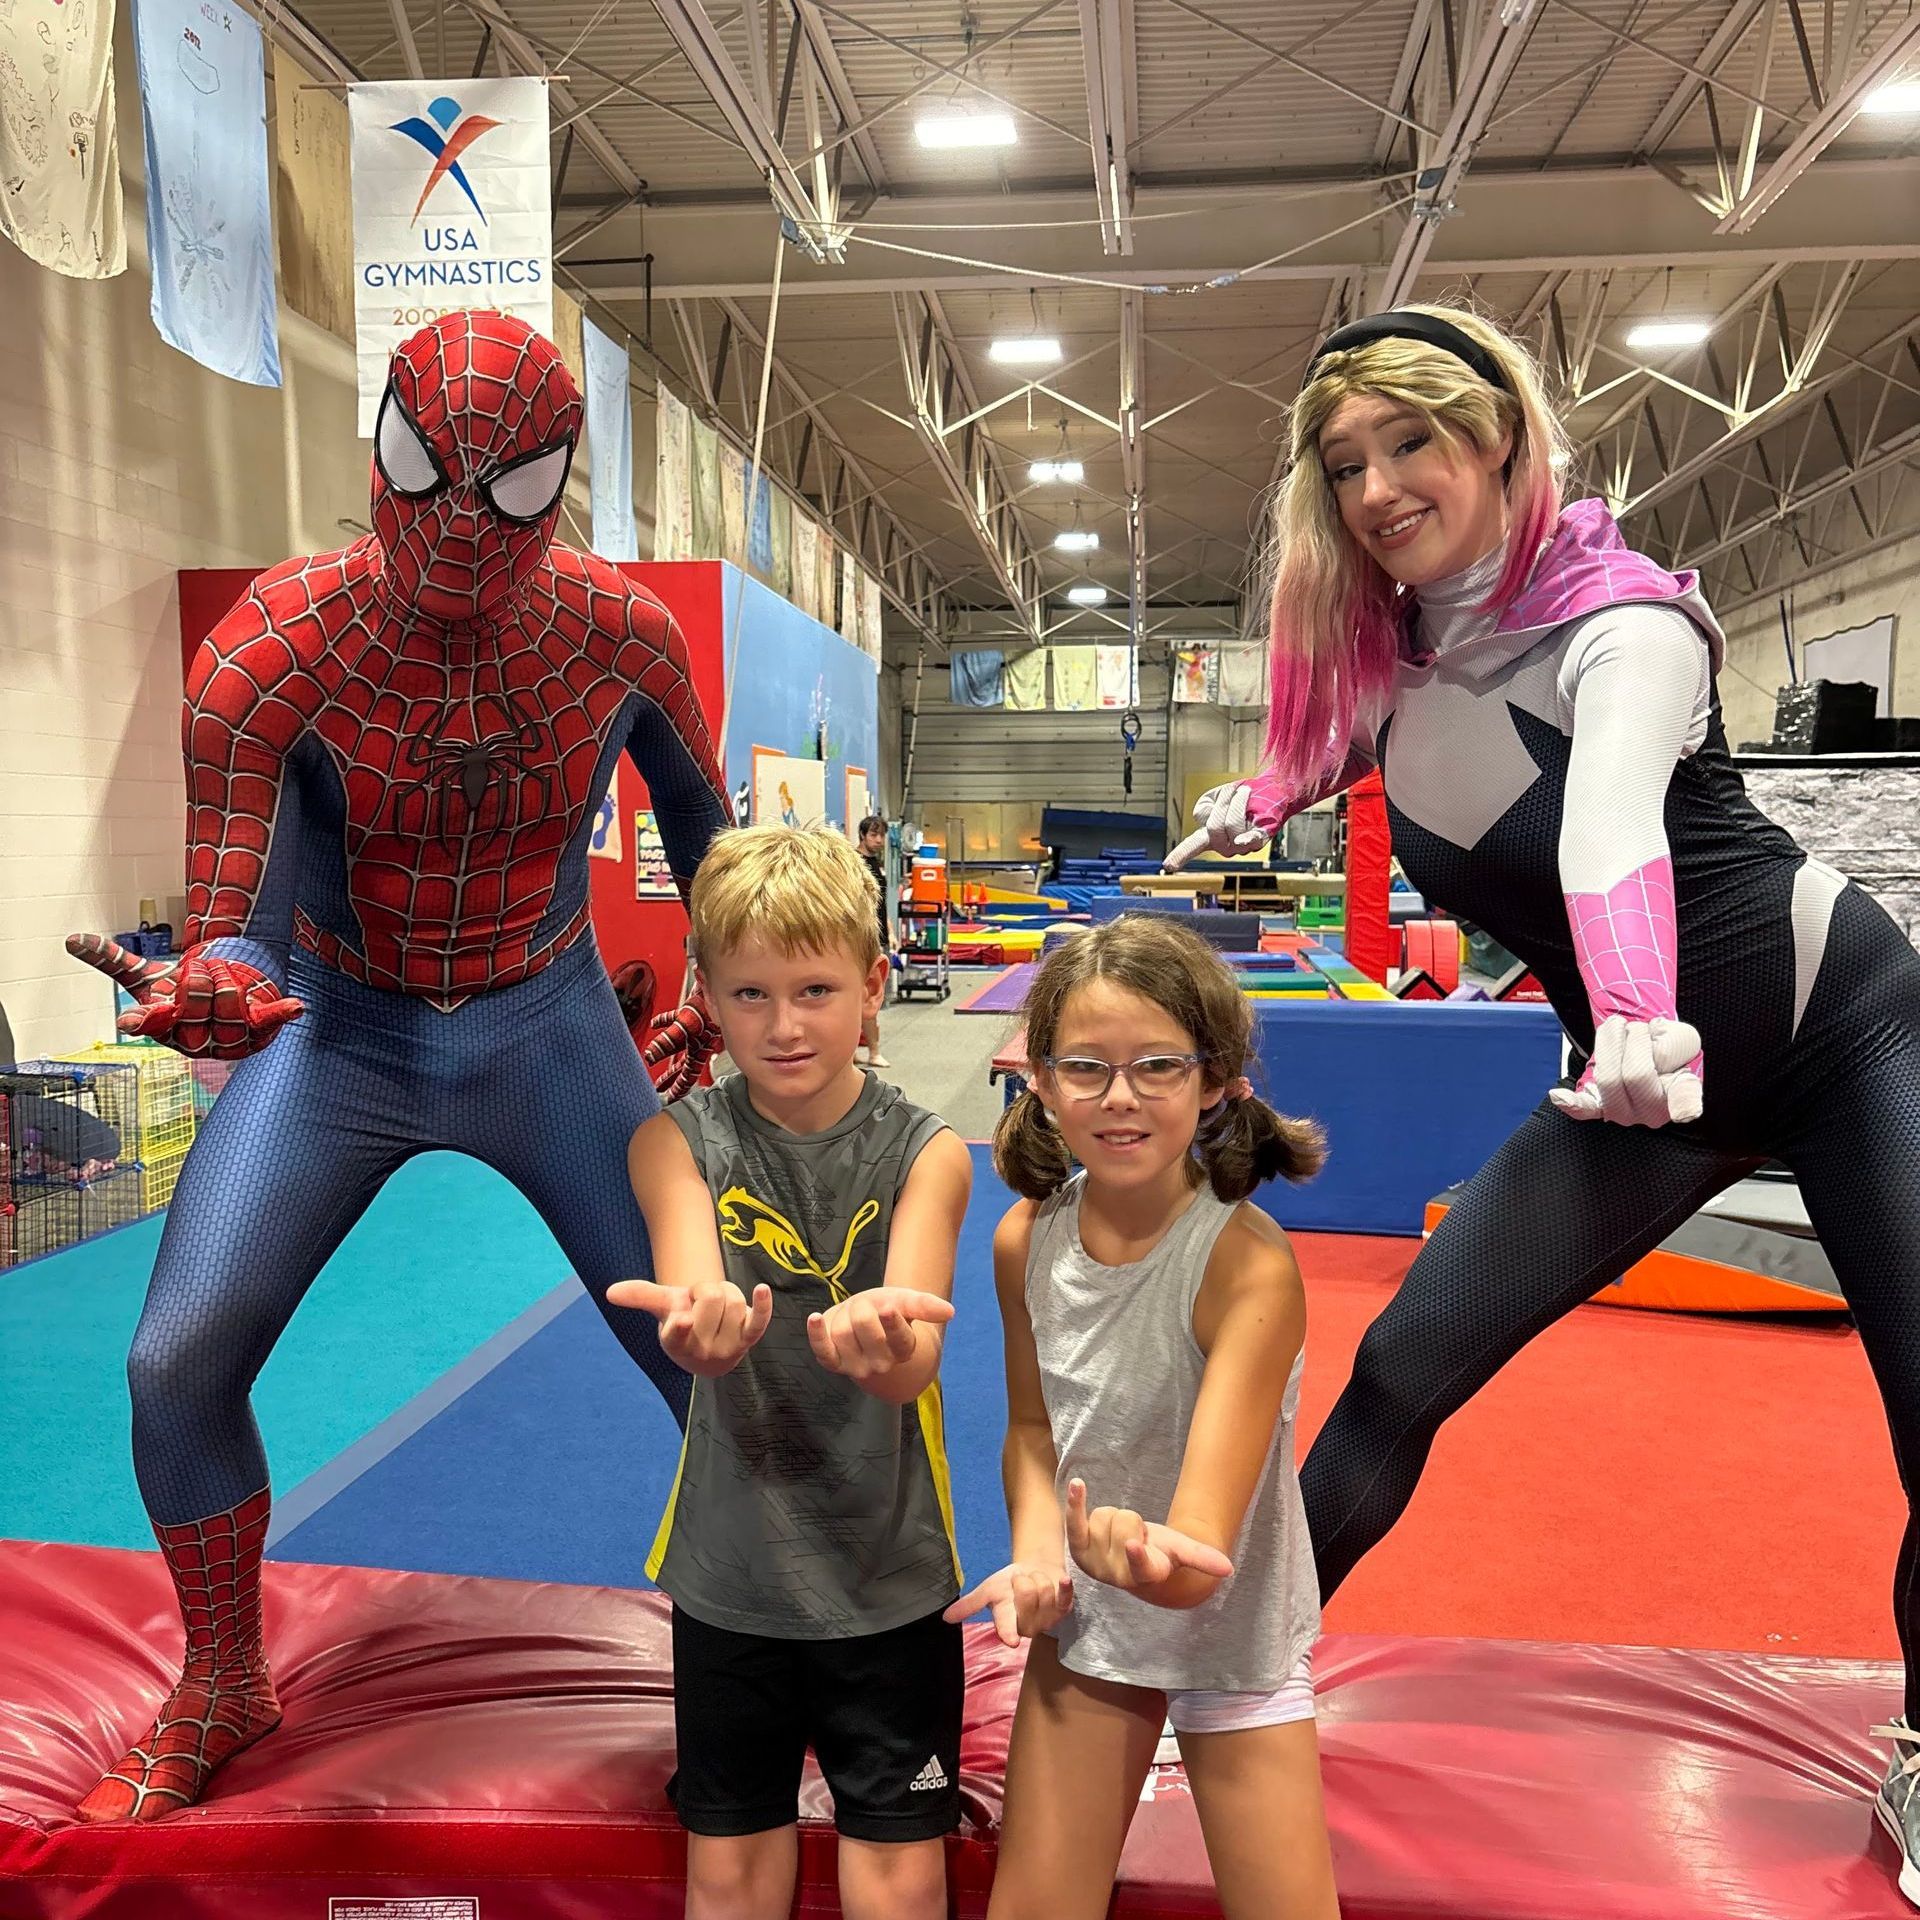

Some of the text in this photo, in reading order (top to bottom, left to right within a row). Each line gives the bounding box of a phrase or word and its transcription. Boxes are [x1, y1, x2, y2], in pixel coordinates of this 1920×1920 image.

[424, 228, 478, 251] USA
[364, 259, 541, 287] GYMNASTICS
[910, 1776, 948, 1791] adidas
